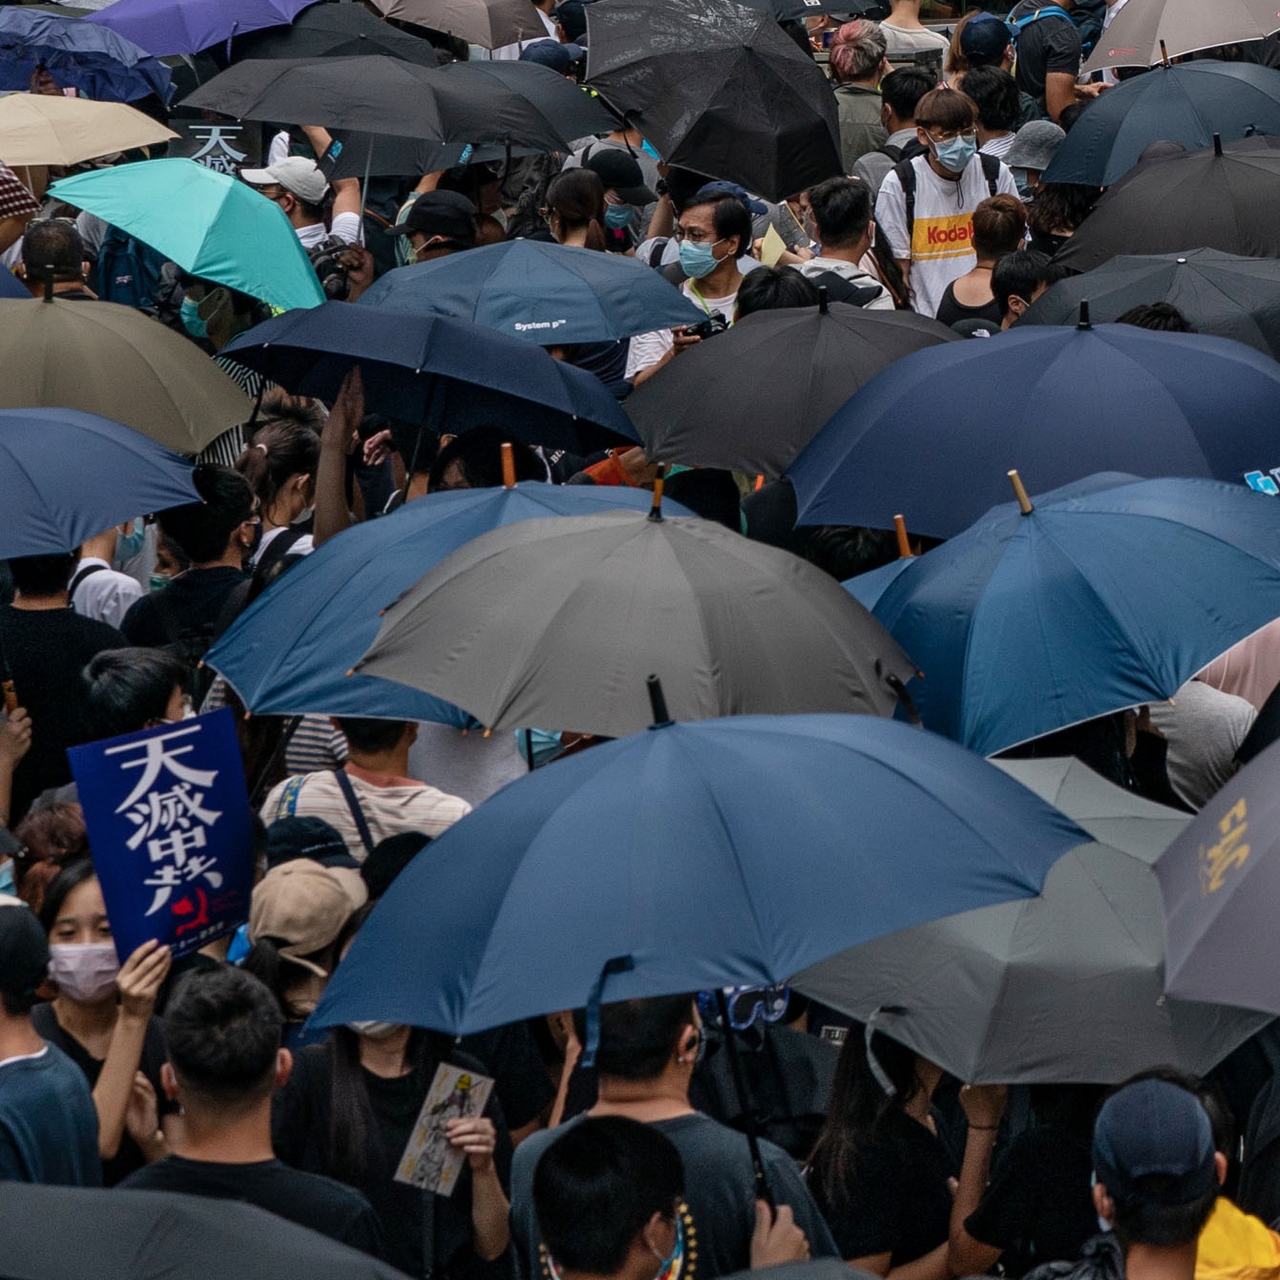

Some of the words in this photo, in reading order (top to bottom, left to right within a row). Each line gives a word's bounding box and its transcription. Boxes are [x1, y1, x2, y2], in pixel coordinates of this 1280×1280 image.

[514, 321, 550, 332] System
[103, 723, 224, 918] 天滅中共
